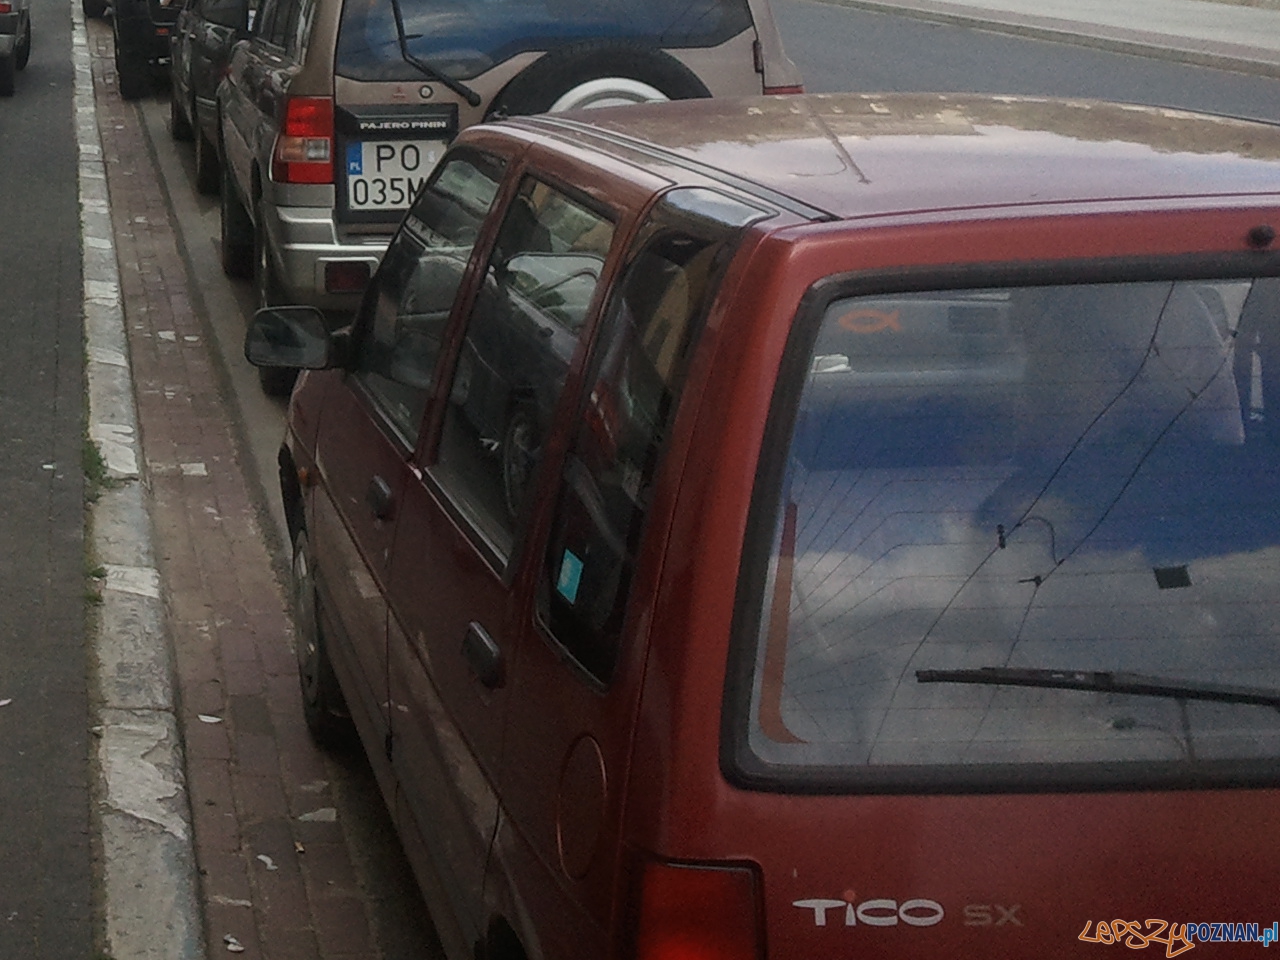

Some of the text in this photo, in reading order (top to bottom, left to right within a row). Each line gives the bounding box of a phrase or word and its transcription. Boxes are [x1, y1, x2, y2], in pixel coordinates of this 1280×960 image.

[360, 121, 410, 129] PAJERO
[376, 144, 420, 172] PO
[963, 904, 1023, 926] SX
